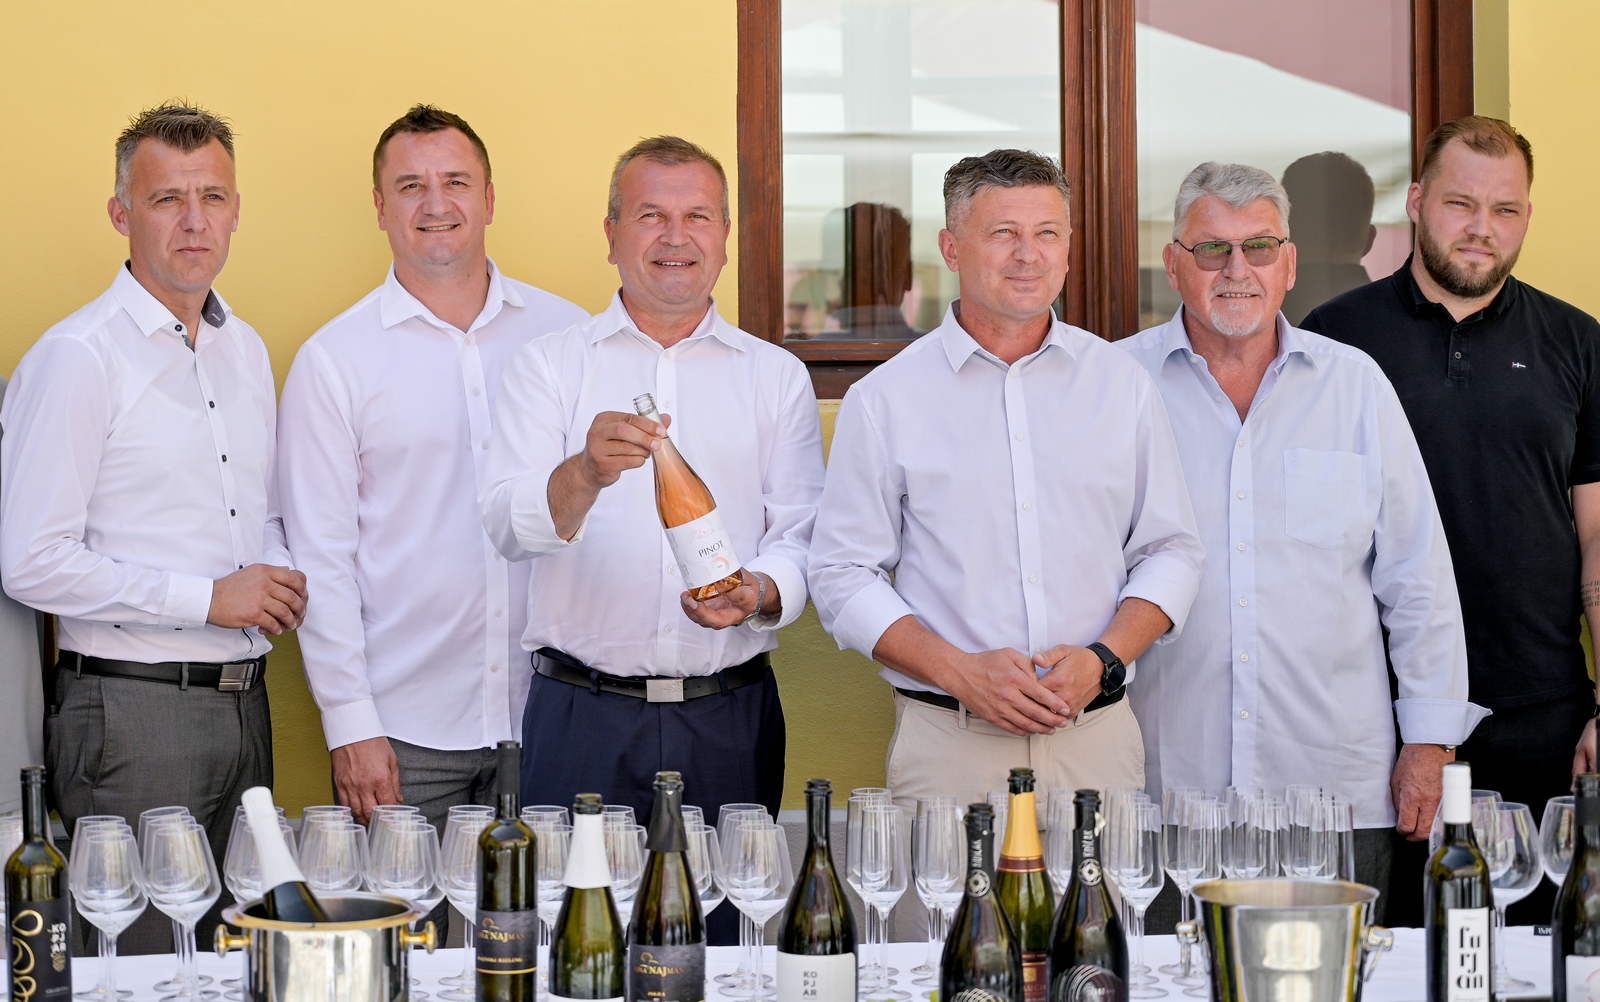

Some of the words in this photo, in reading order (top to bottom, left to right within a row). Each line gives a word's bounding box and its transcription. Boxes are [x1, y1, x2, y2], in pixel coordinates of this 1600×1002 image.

[698, 539, 724, 557] PINOT
[51, 922, 67, 933] KO
[489, 931, 526, 943] NAJMAN
[648, 965, 685, 977] NAJMAN
